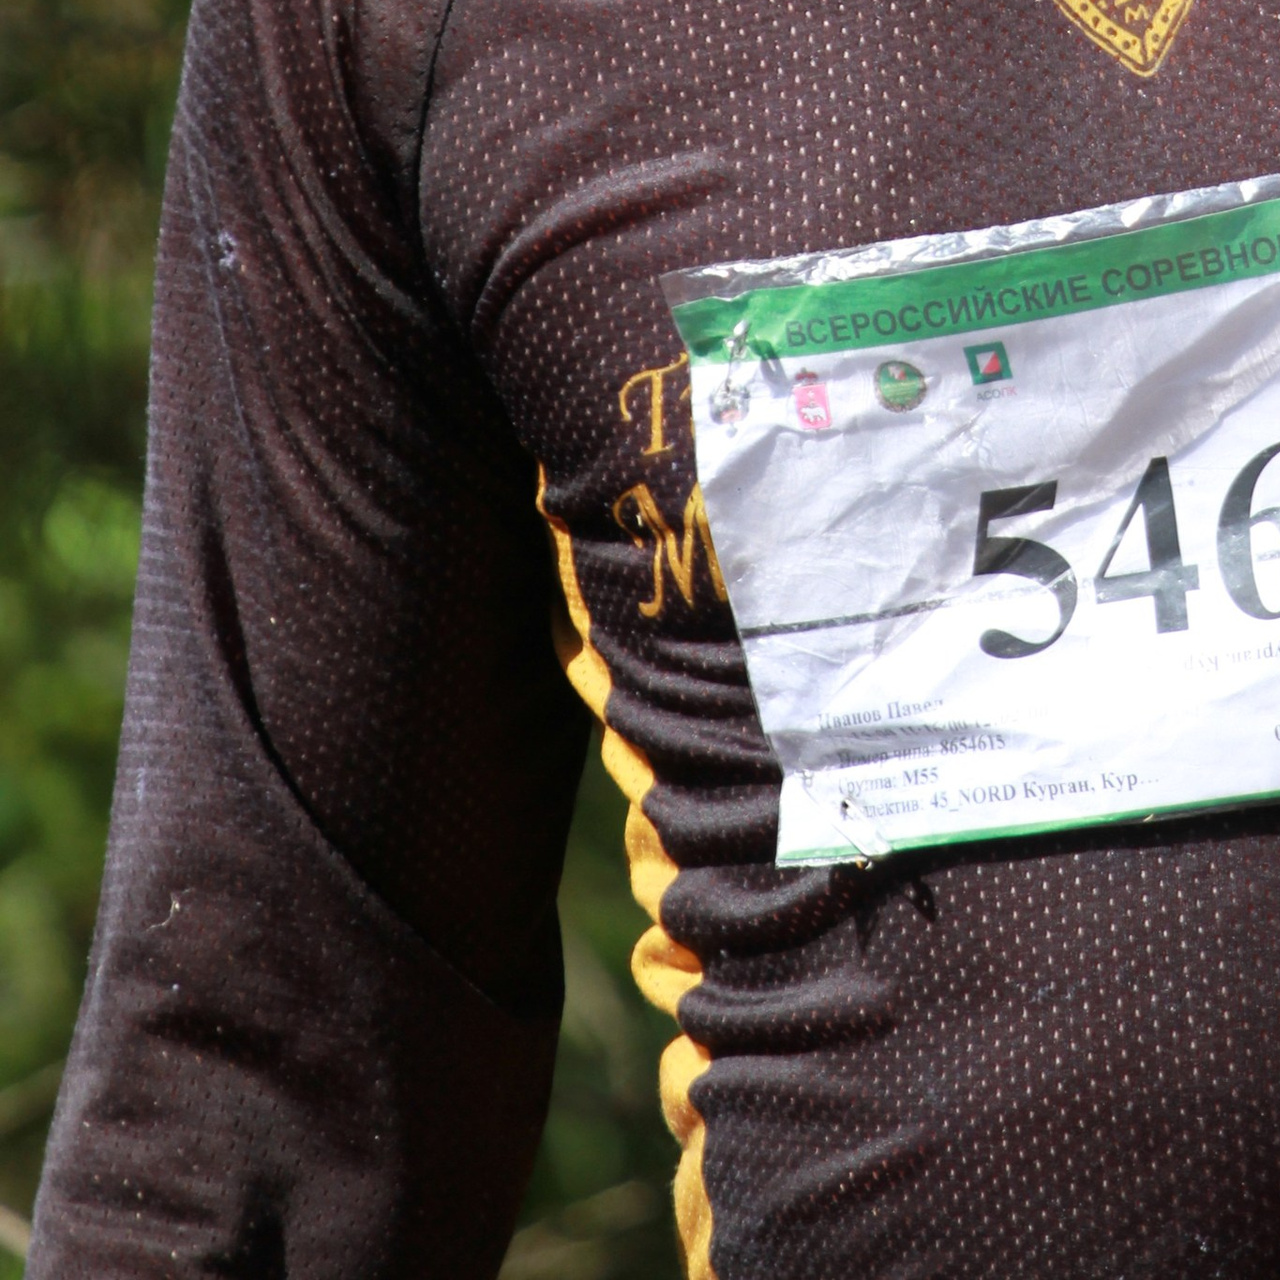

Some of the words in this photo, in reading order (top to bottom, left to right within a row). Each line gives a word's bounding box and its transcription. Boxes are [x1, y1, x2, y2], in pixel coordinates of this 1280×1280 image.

[785, 274, 1092, 347] ВСЕРОССИЙСКИЕ
[939, 734, 1006, 756] 8654615
[930, 783, 1017, 811] 45_NORD
[1023, 777, 1097, 800] Курган,
